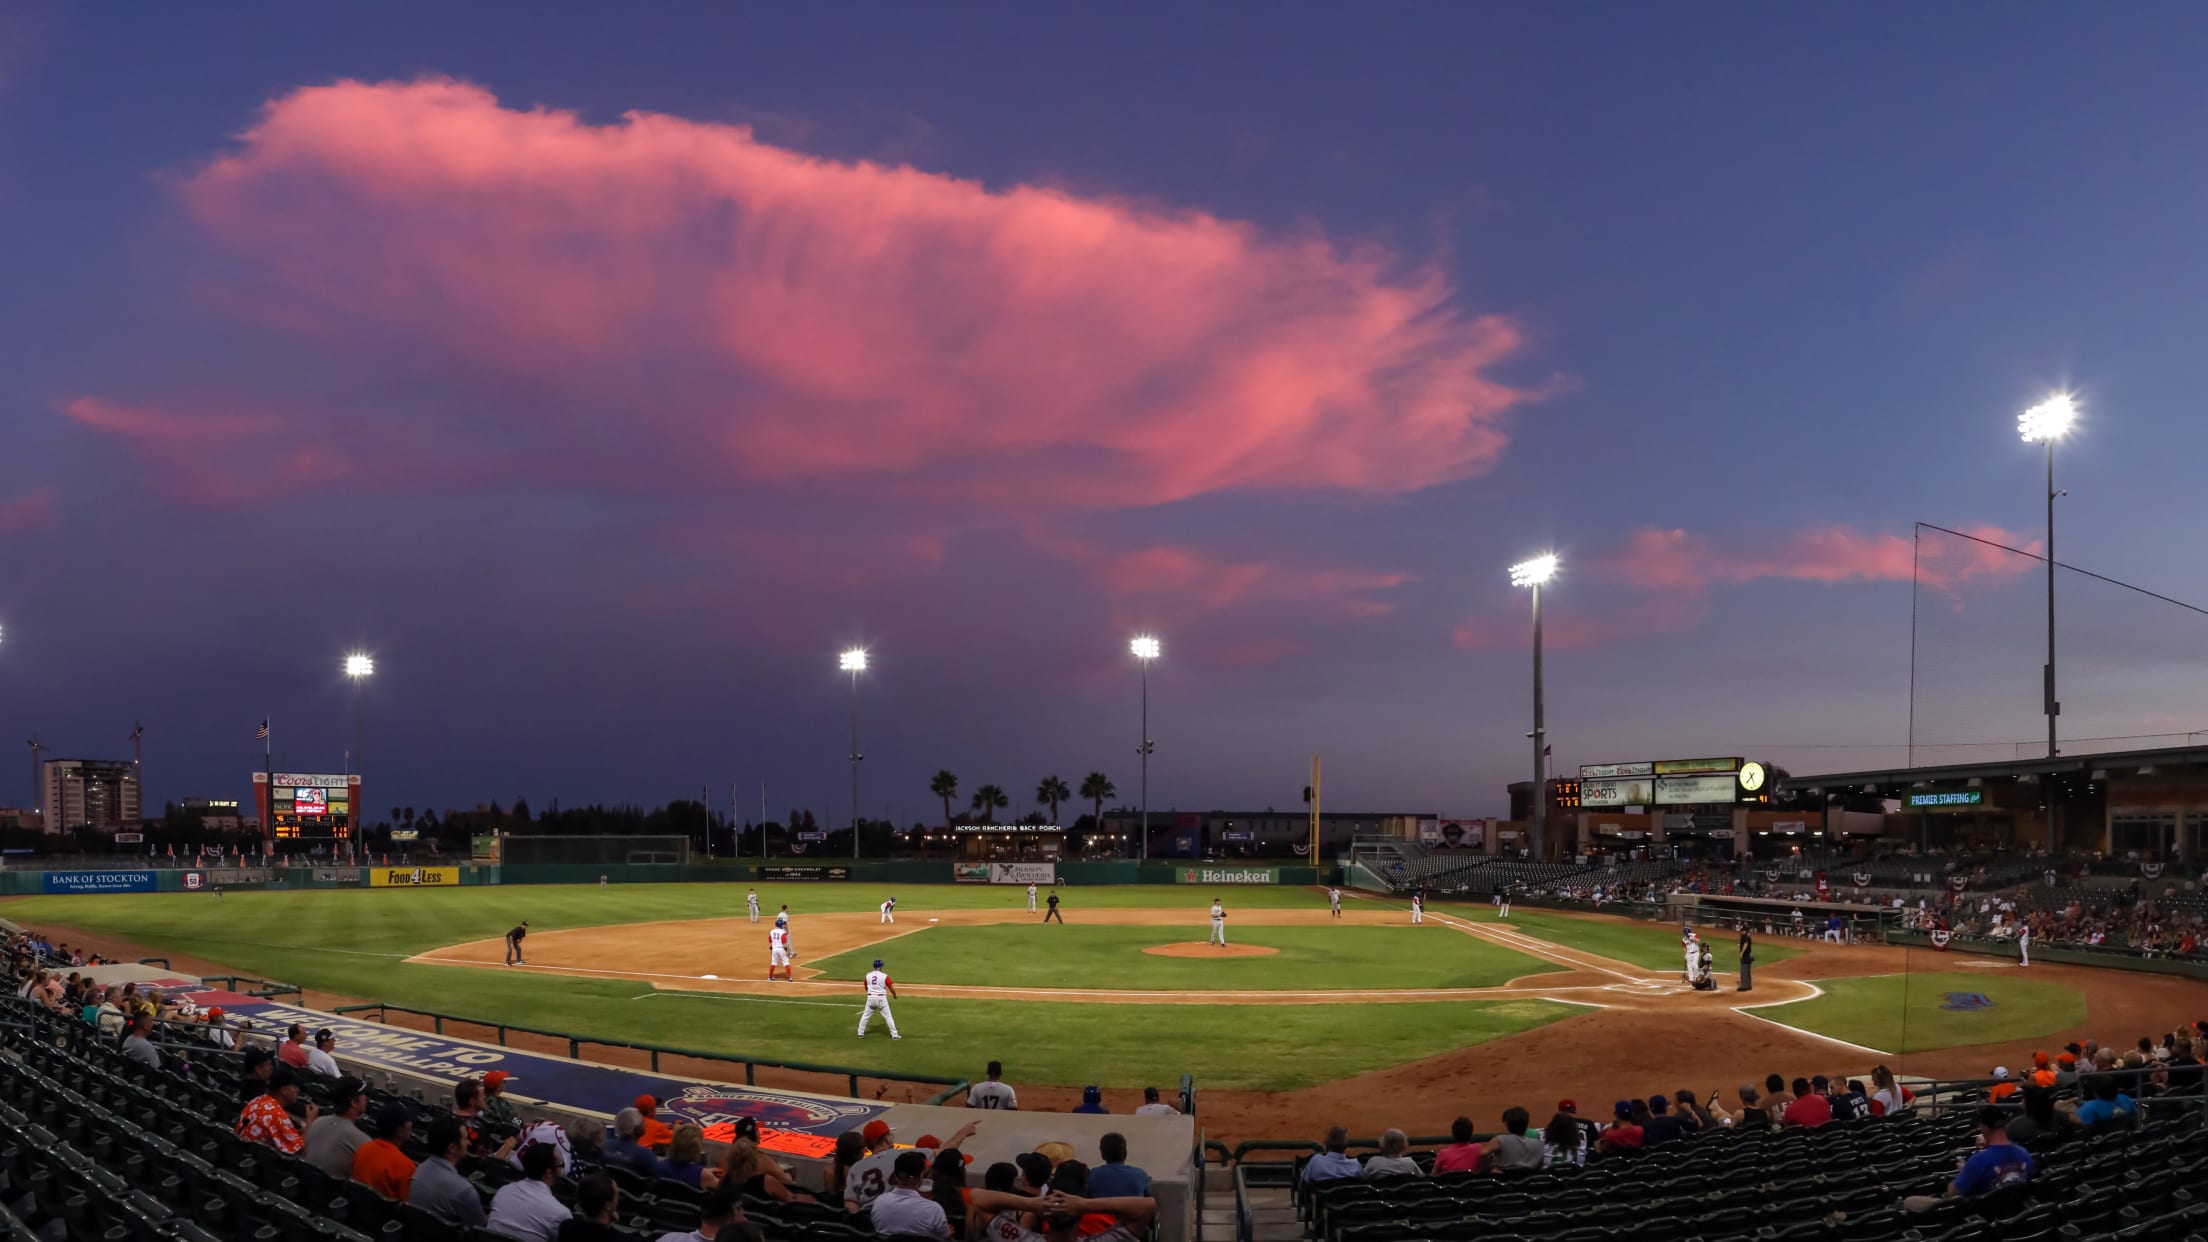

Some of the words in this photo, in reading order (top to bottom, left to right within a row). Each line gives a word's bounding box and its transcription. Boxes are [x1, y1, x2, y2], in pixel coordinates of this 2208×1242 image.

[313, 776, 346, 786] LIGHT
[1583, 788, 1617, 800] SPORTS
[1911, 794, 1938, 806] PREMIER
[1939, 793, 1969, 804] STAFFING
[52, 875, 79, 884] BANK
[81, 875, 94, 883] OF
[96, 874, 148, 883] STOCKTON
[1202, 870, 1270, 883] Heineken
[871, 976, 878, 985] 2
[254, 1009, 447, 1051] WELCOME
[429, 1047, 505, 1064] TO
[352, 1046, 520, 1081] BALLPAR
[982, 1095, 1000, 1109] 17
